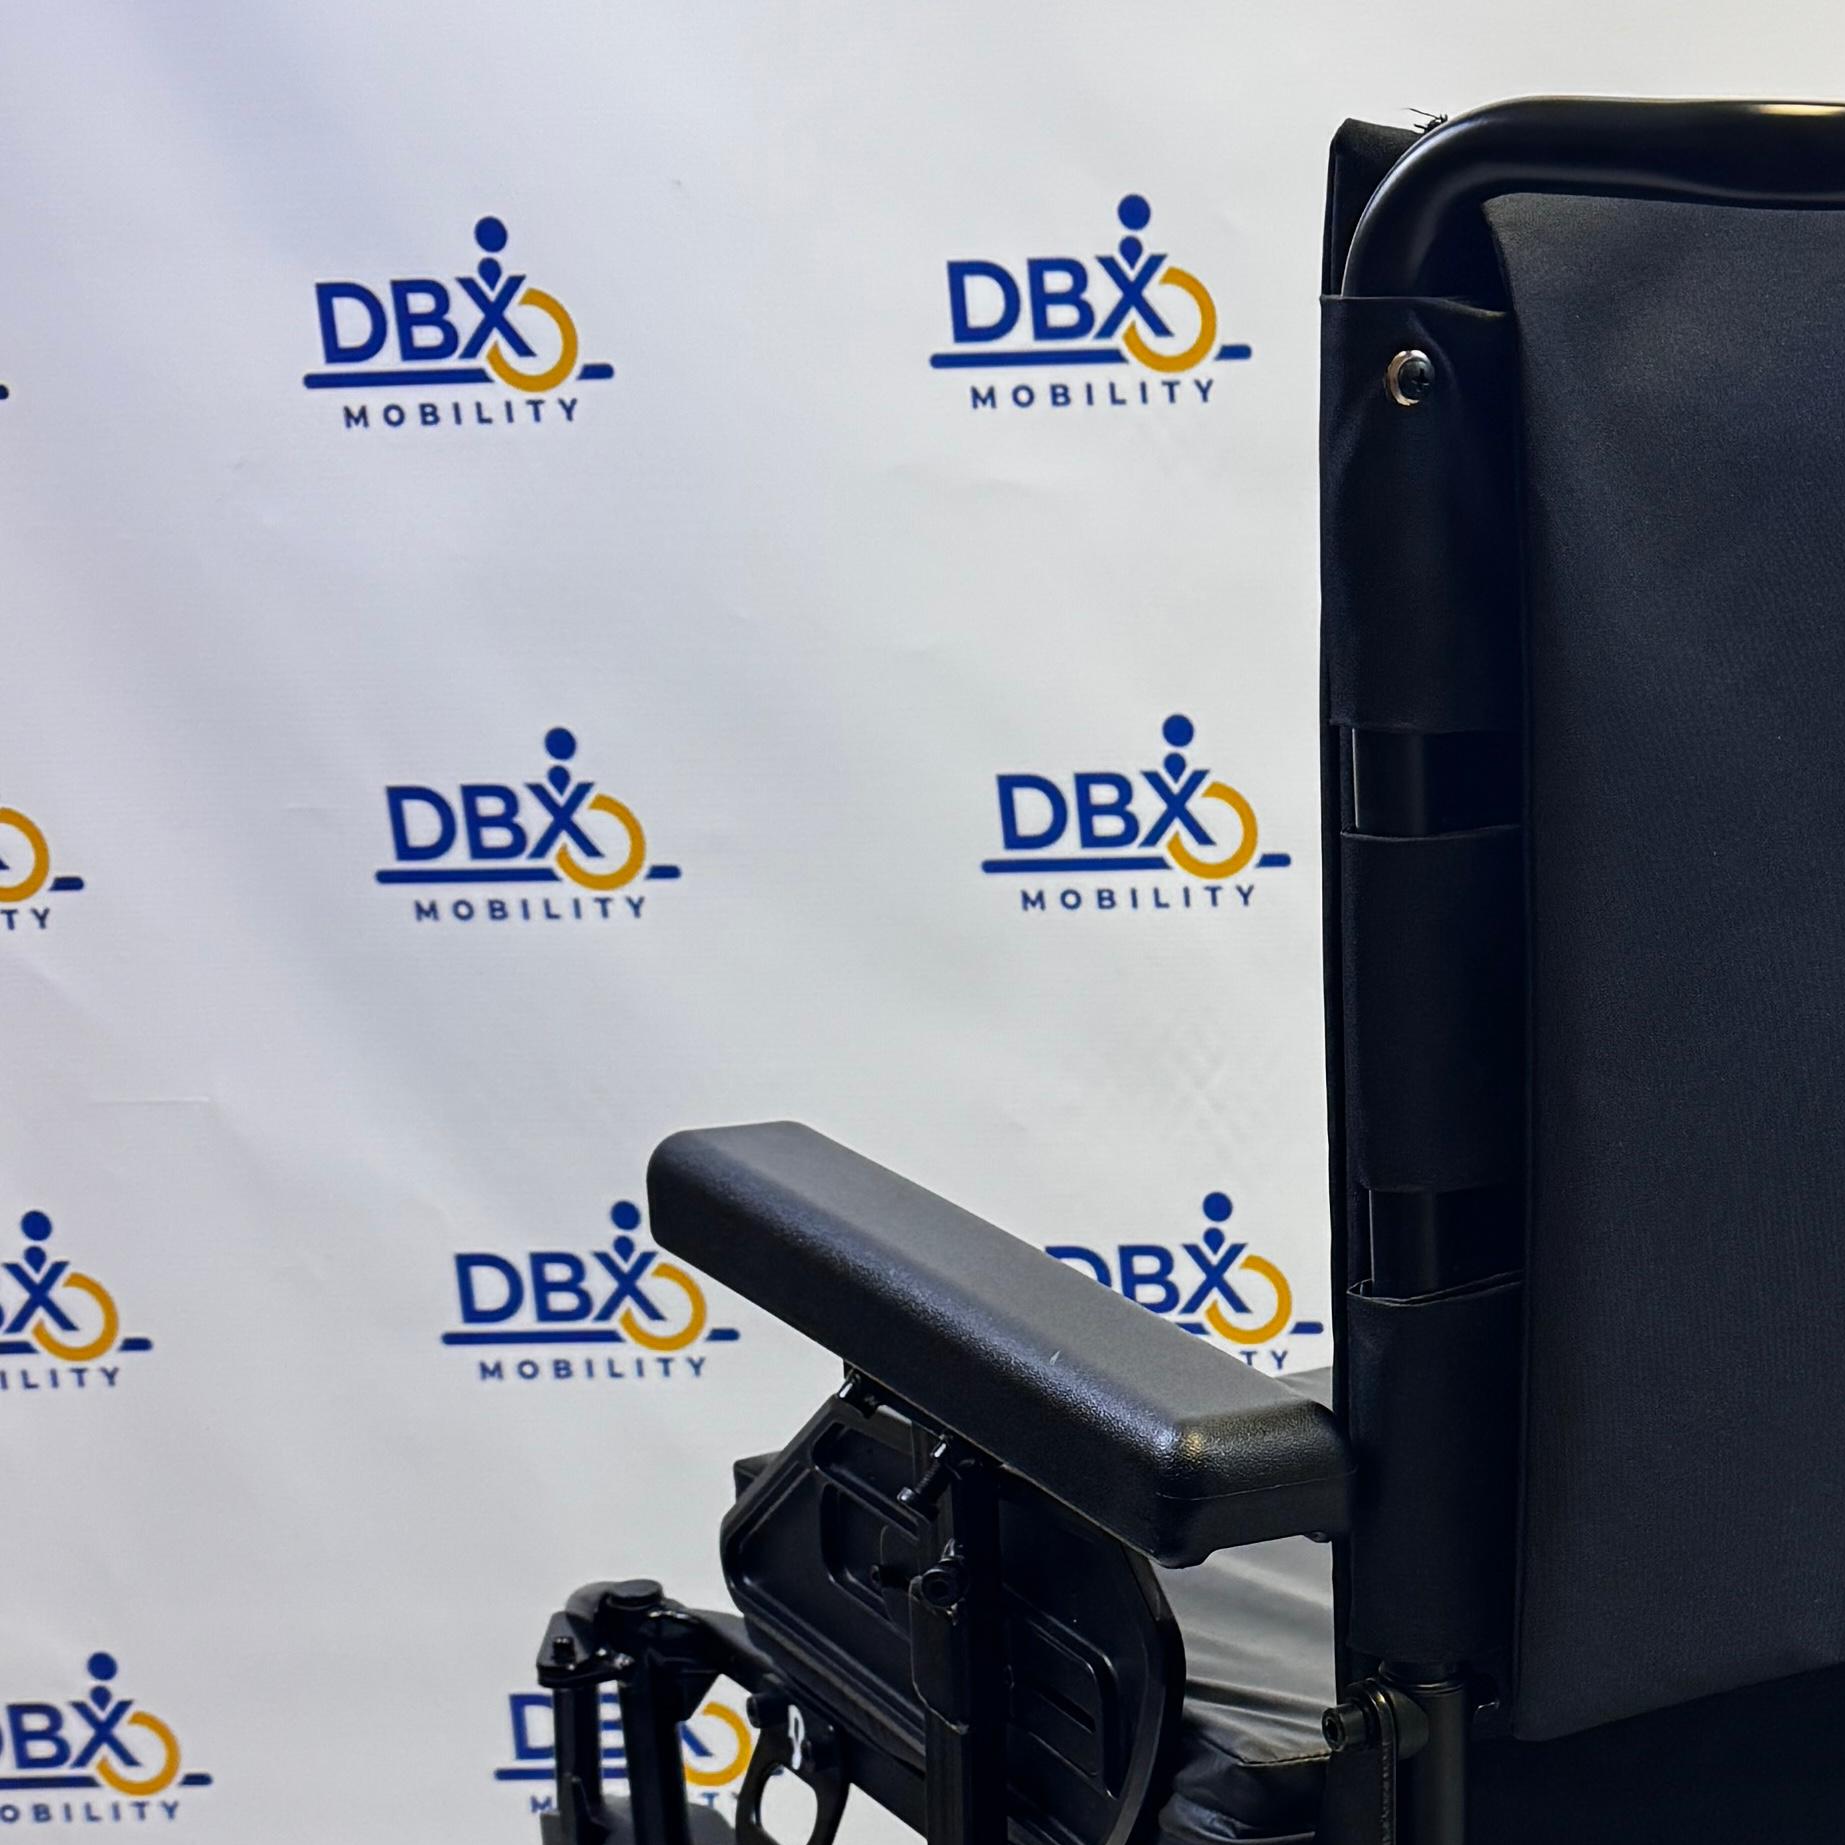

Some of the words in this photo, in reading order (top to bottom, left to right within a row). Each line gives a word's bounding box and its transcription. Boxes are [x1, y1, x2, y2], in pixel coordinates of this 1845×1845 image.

[946, 254, 1173, 345] DBX
[315, 274, 537, 364] DBX
[972, 380, 1216, 409] MOBILITY
[343, 398, 579, 429] MOBILITY
[385, 782, 604, 861] DBX
[995, 769, 1215, 851] DBX
[414, 895, 646, 922] MOBILITY
[1021, 881, 1256, 909] MOBILITY
[455, 1250, 665, 1325] DBX
[0, 1367, 118, 1389] ILITY
[478, 1357, 706, 1381] MOBILITY
[0, 1700, 141, 1769] BX
[0, 1801, 178, 1823] OBILITY
